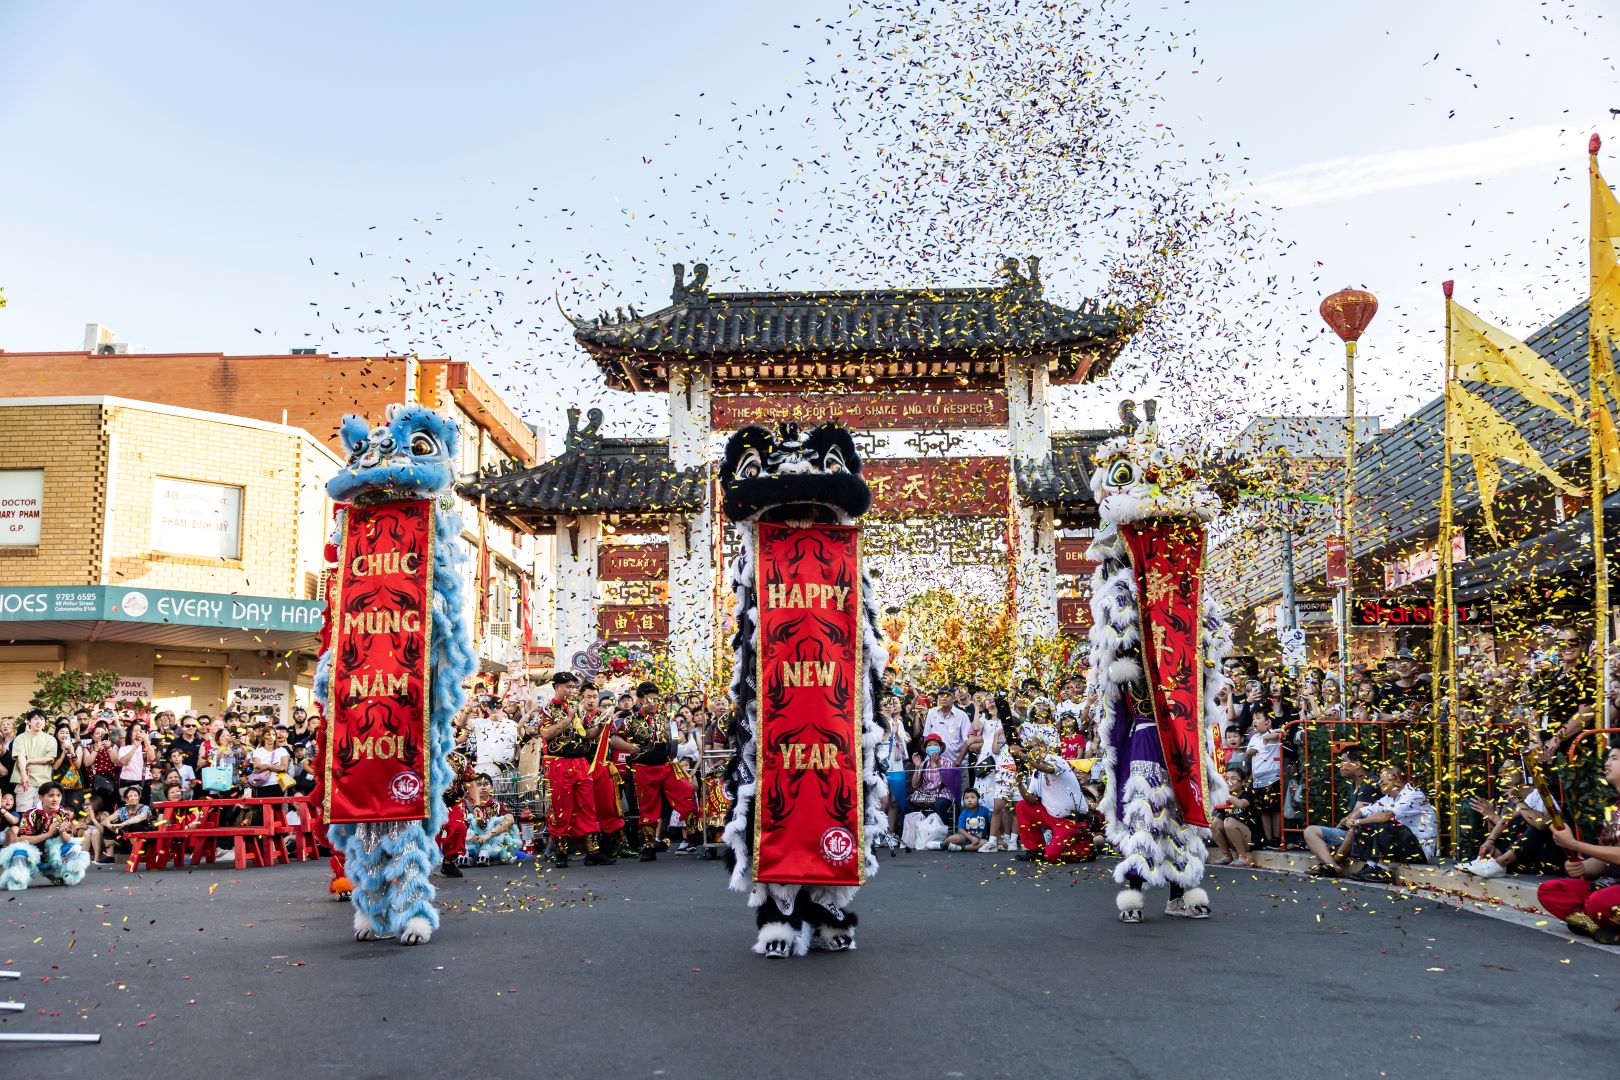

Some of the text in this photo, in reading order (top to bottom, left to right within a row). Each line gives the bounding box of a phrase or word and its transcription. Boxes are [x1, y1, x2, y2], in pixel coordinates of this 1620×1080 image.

[732, 408, 751, 418] THE
[755, 407, 788, 418] ORLD
[807, 407, 826, 417] FOR
[903, 404, 922, 415] AND
[926, 404, 939, 414] TO
[943, 402, 990, 414] RESPECT
[0, 510, 40, 519] ARY PHAM
[1, 499, 37, 507] DOCTOR
[1243, 498, 1298, 514] ARTUR
[351, 548, 418, 577] CHÚC
[0, 593, 48, 613] OES
[767, 582, 849, 612] HAPPY
[157, 597, 325, 625] EVERY DAY HAP
[1363, 602, 1467, 623] Shareta
[350, 669, 410, 697] NĂM
[783, 661, 836, 687] NEW
[352, 730, 404, 760] MỚI
[780, 744, 839, 771] YEAR
